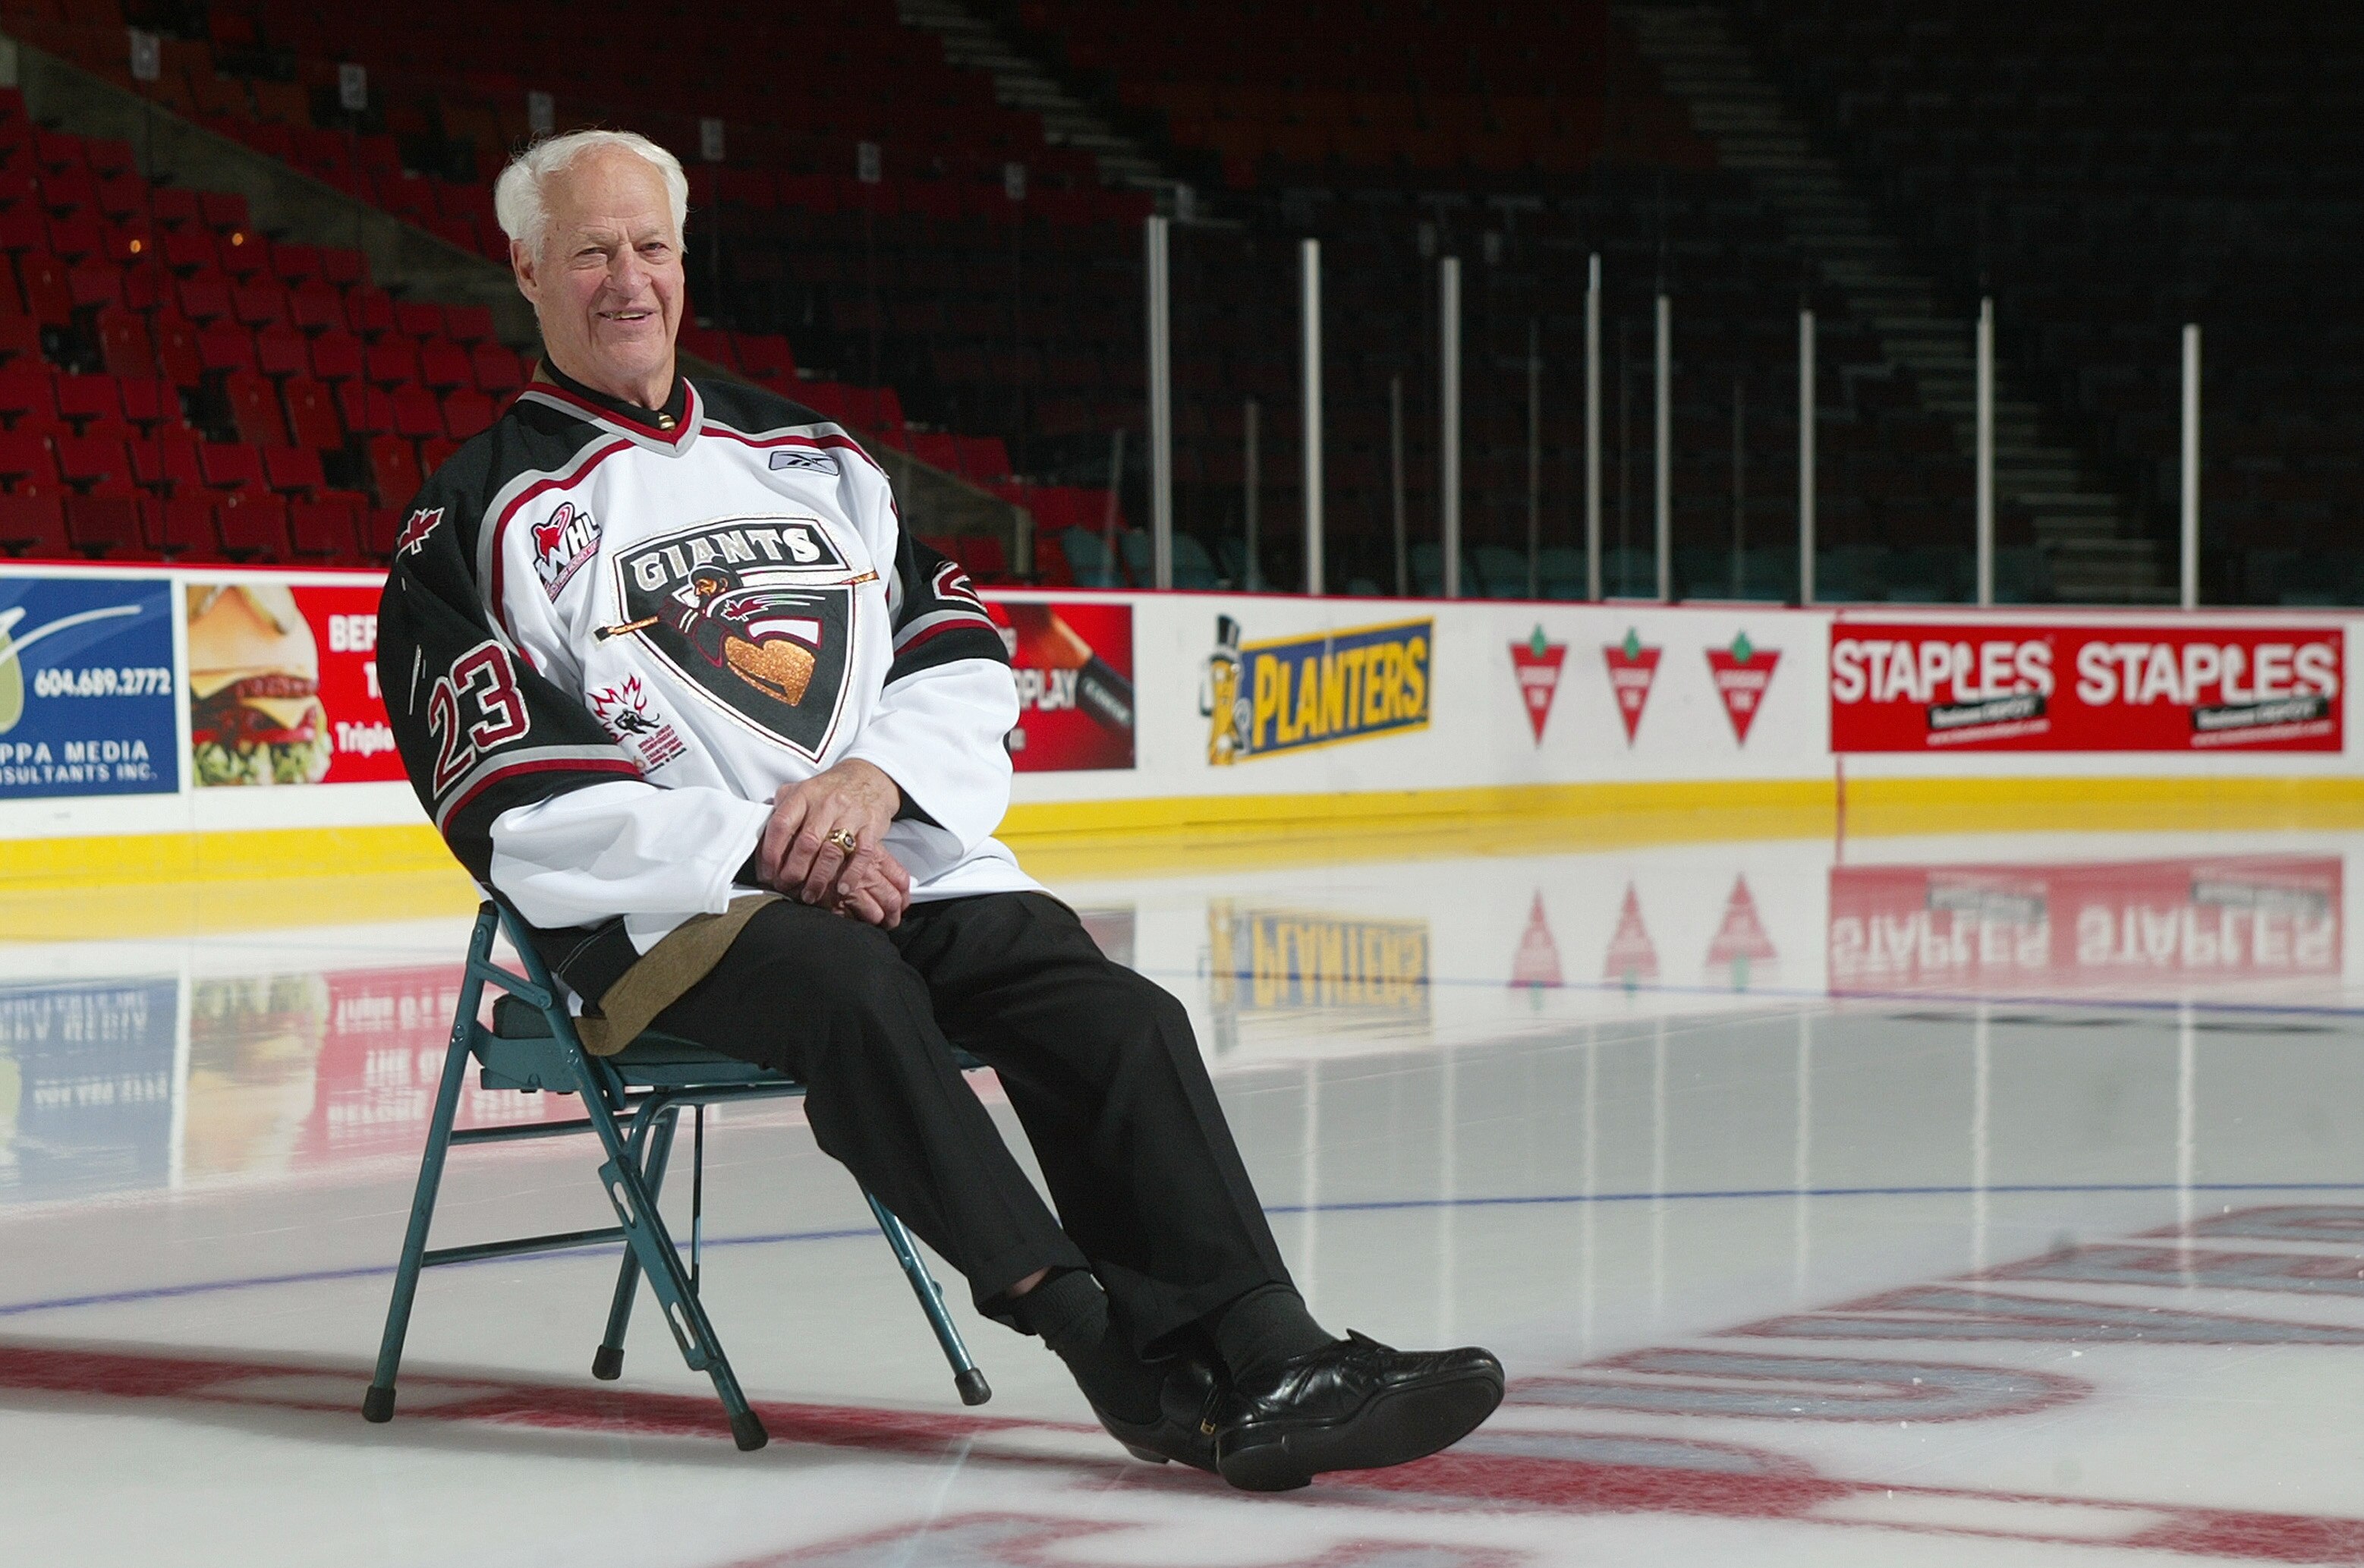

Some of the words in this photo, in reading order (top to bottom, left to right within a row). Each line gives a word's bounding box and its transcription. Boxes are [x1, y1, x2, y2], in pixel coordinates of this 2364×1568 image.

[534, 512, 602, 585] WHL
[631, 528, 821, 591] GIANTS
[1252, 636, 1428, 748] PLANTERS
[1832, 638, 2054, 704] STAPLES
[2076, 641, 2337, 706] STAPLES
[65, 739, 150, 764] MEDIA
[428, 639, 530, 801] 23
[0, 764, 110, 786] SULTANTS
[116, 762, 158, 782] INC.
